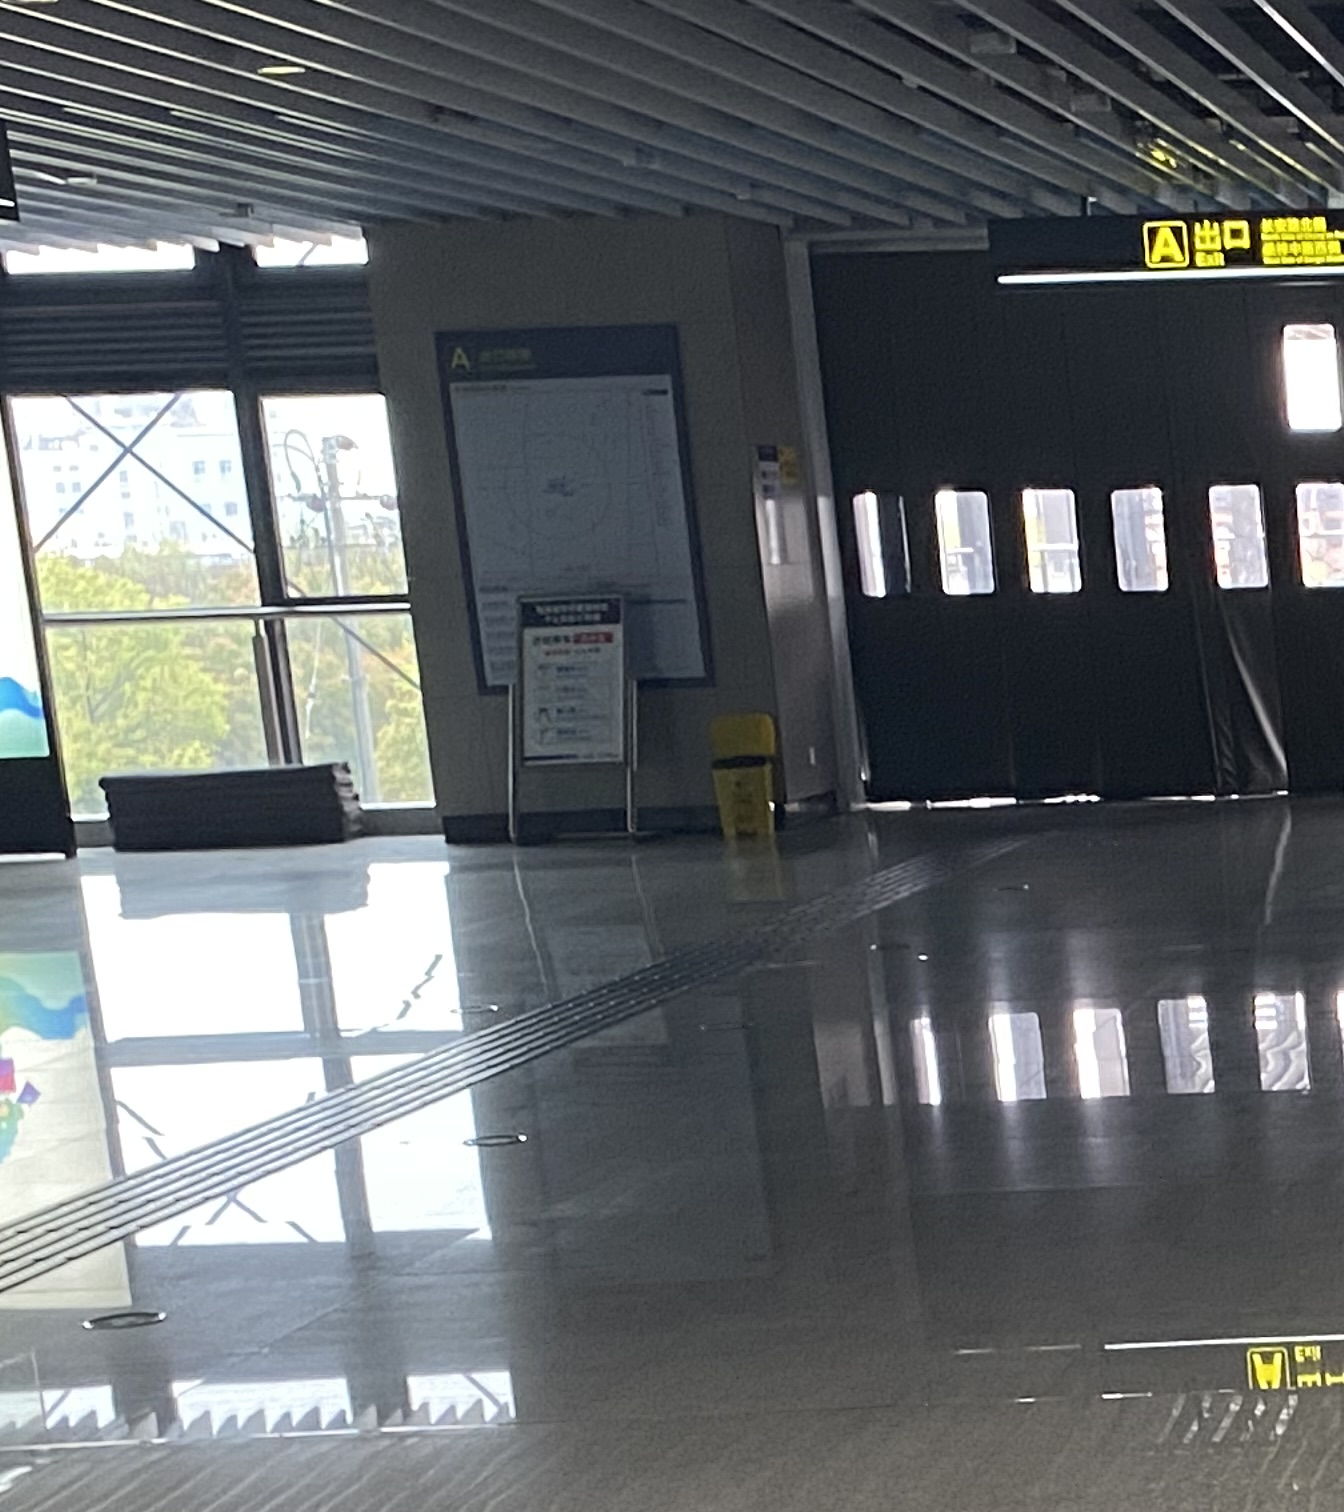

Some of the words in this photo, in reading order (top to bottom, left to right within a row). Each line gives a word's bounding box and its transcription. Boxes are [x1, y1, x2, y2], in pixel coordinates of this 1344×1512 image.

[1151, 225, 1185, 263] A
[1194, 219, 1250, 251] 出口
[451, 347, 471, 370] A
